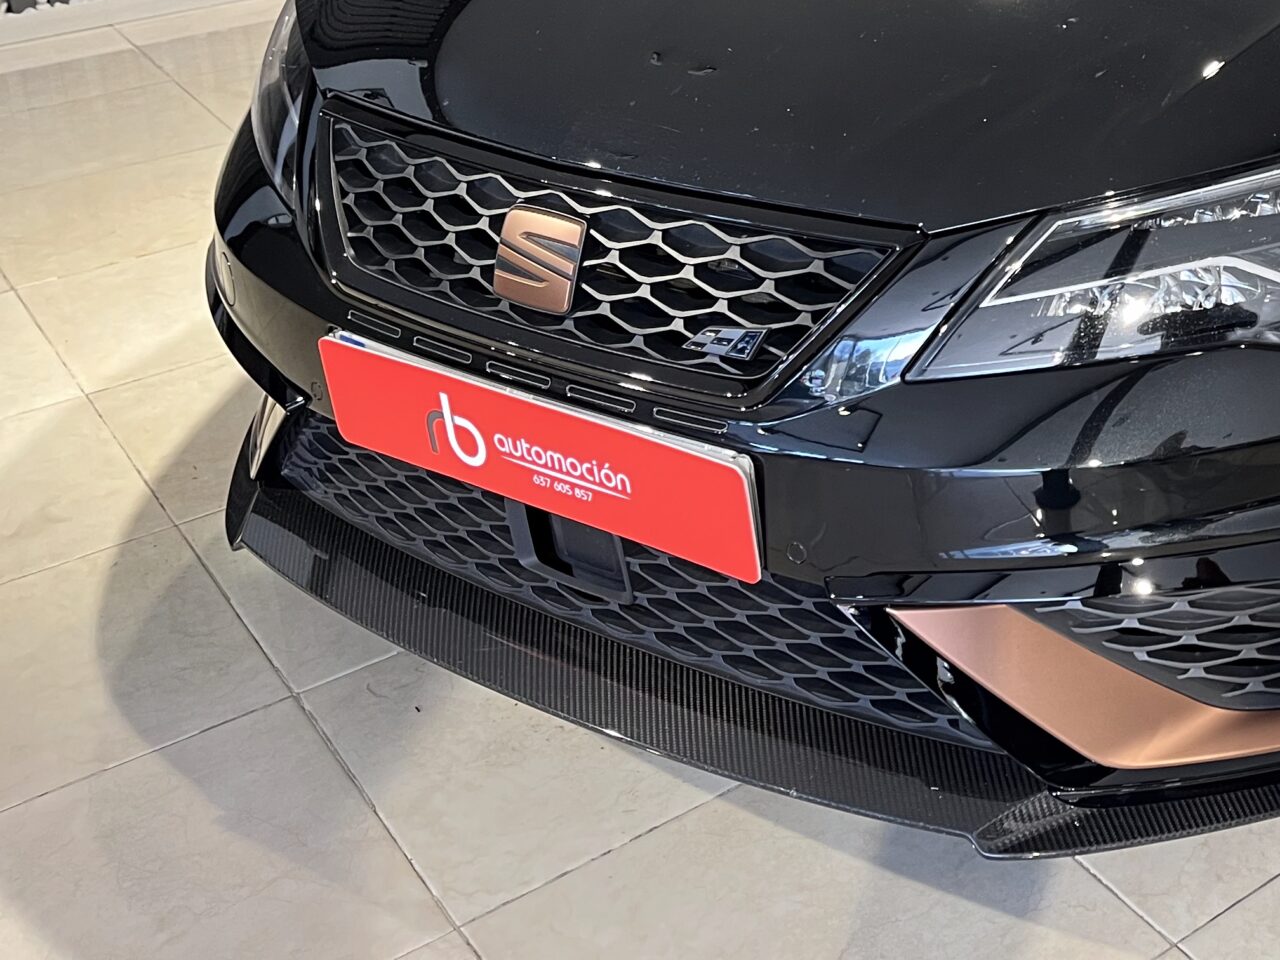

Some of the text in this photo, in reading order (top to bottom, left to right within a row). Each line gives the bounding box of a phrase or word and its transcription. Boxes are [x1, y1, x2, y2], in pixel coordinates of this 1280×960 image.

[426, 391, 632, 494] rb automoción
[553, 481, 573, 496] 605
[574, 487, 593, 502] 857
